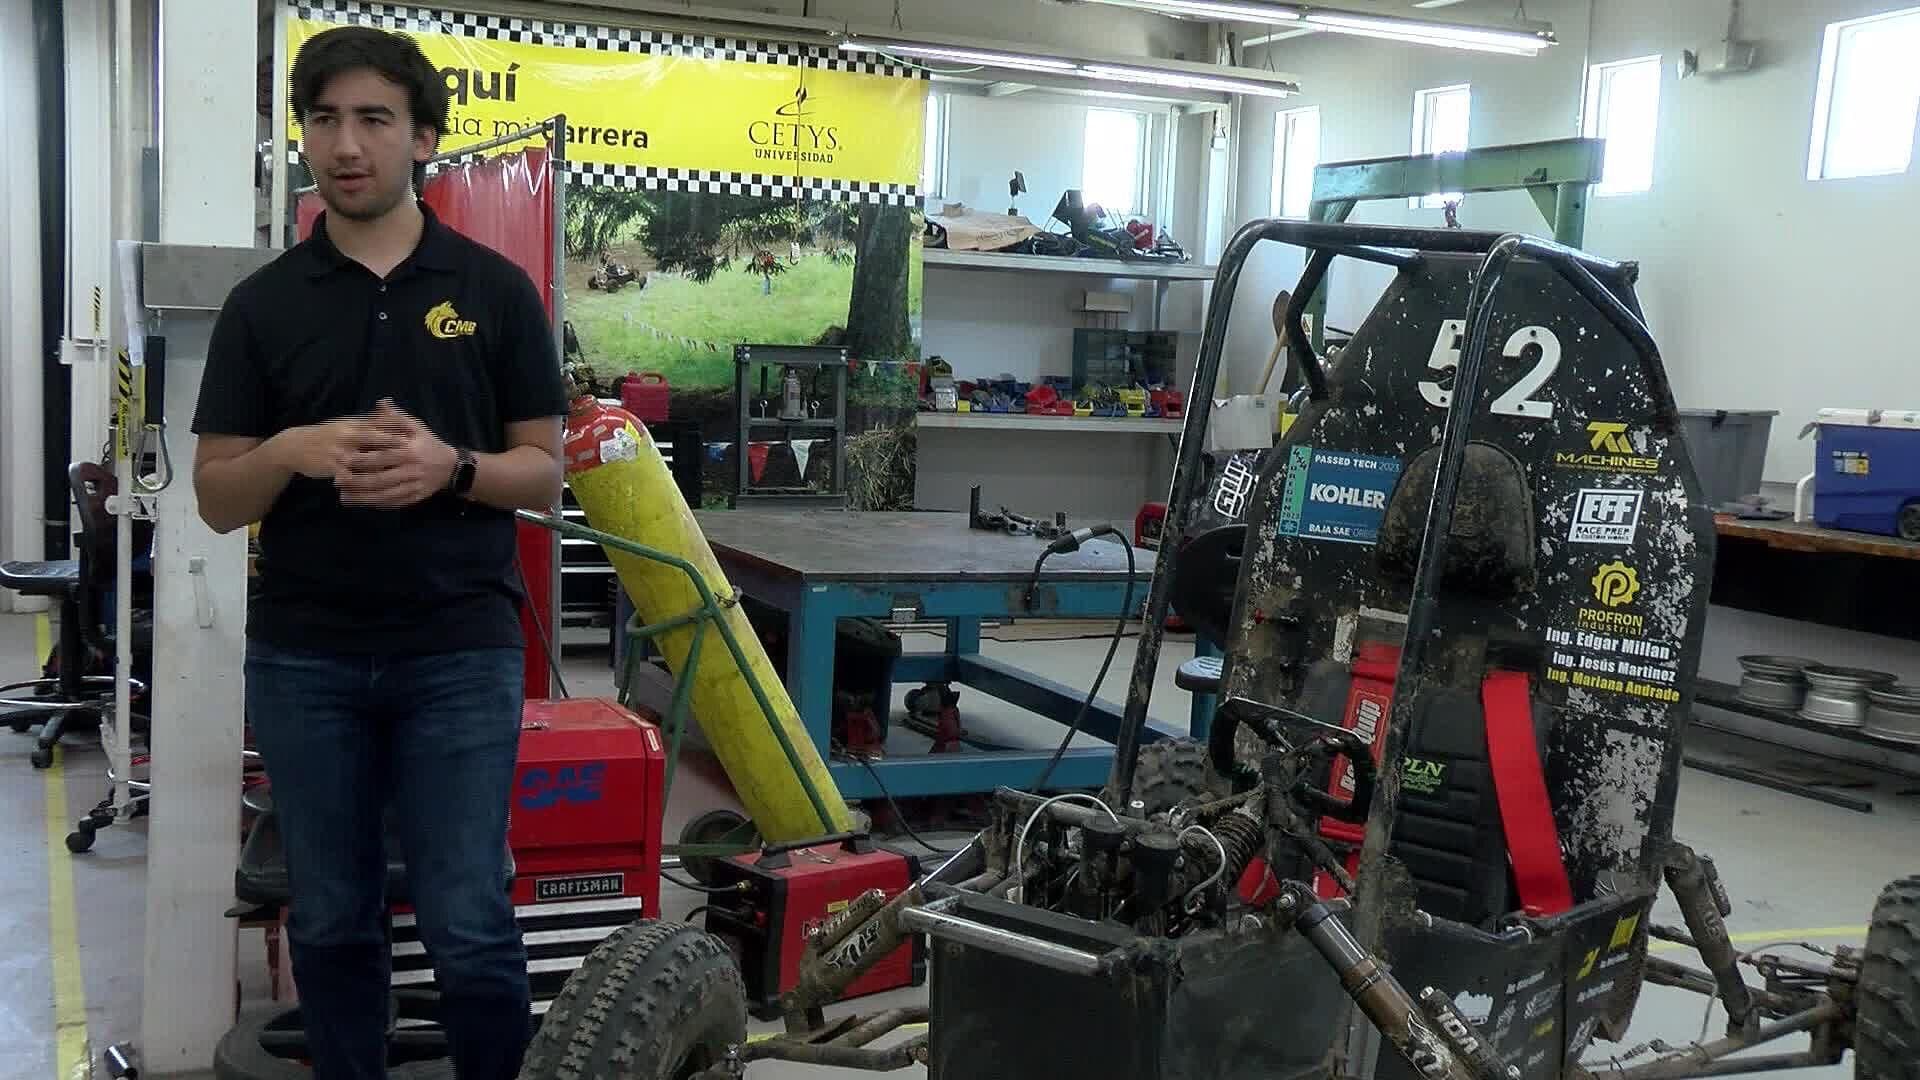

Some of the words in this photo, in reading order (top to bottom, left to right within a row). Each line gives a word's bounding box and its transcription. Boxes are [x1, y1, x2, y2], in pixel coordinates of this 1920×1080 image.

[437, 62, 521, 105] quí
[748, 120, 838, 151] CETYS
[755, 148, 834, 164] UNIVERSIDAD
[1315, 454, 1351, 466] PASSED
[1353, 459, 1377, 469] TECH
[1556, 452, 1659, 469] MACHINES
[1310, 482, 1386, 510] KOHLER
[1580, 494, 1636, 524] EFF
[1309, 523, 1332, 535] BAJA
[1333, 526, 1351, 537] SAE
[1575, 525, 1602, 535] RACE
[1579, 607, 1643, 627] PROFRON
[1546, 627, 1573, 646] Ing.
[1577, 631, 1619, 651] Edgar
[1553, 651, 1576, 668] Ing.
[1547, 667, 1570, 684] Ing.
[1572, 671, 1624, 692] Mariana
[1625, 680, 1681, 703] Andrade
[542, 878, 619, 896] CRAFTSMAN
